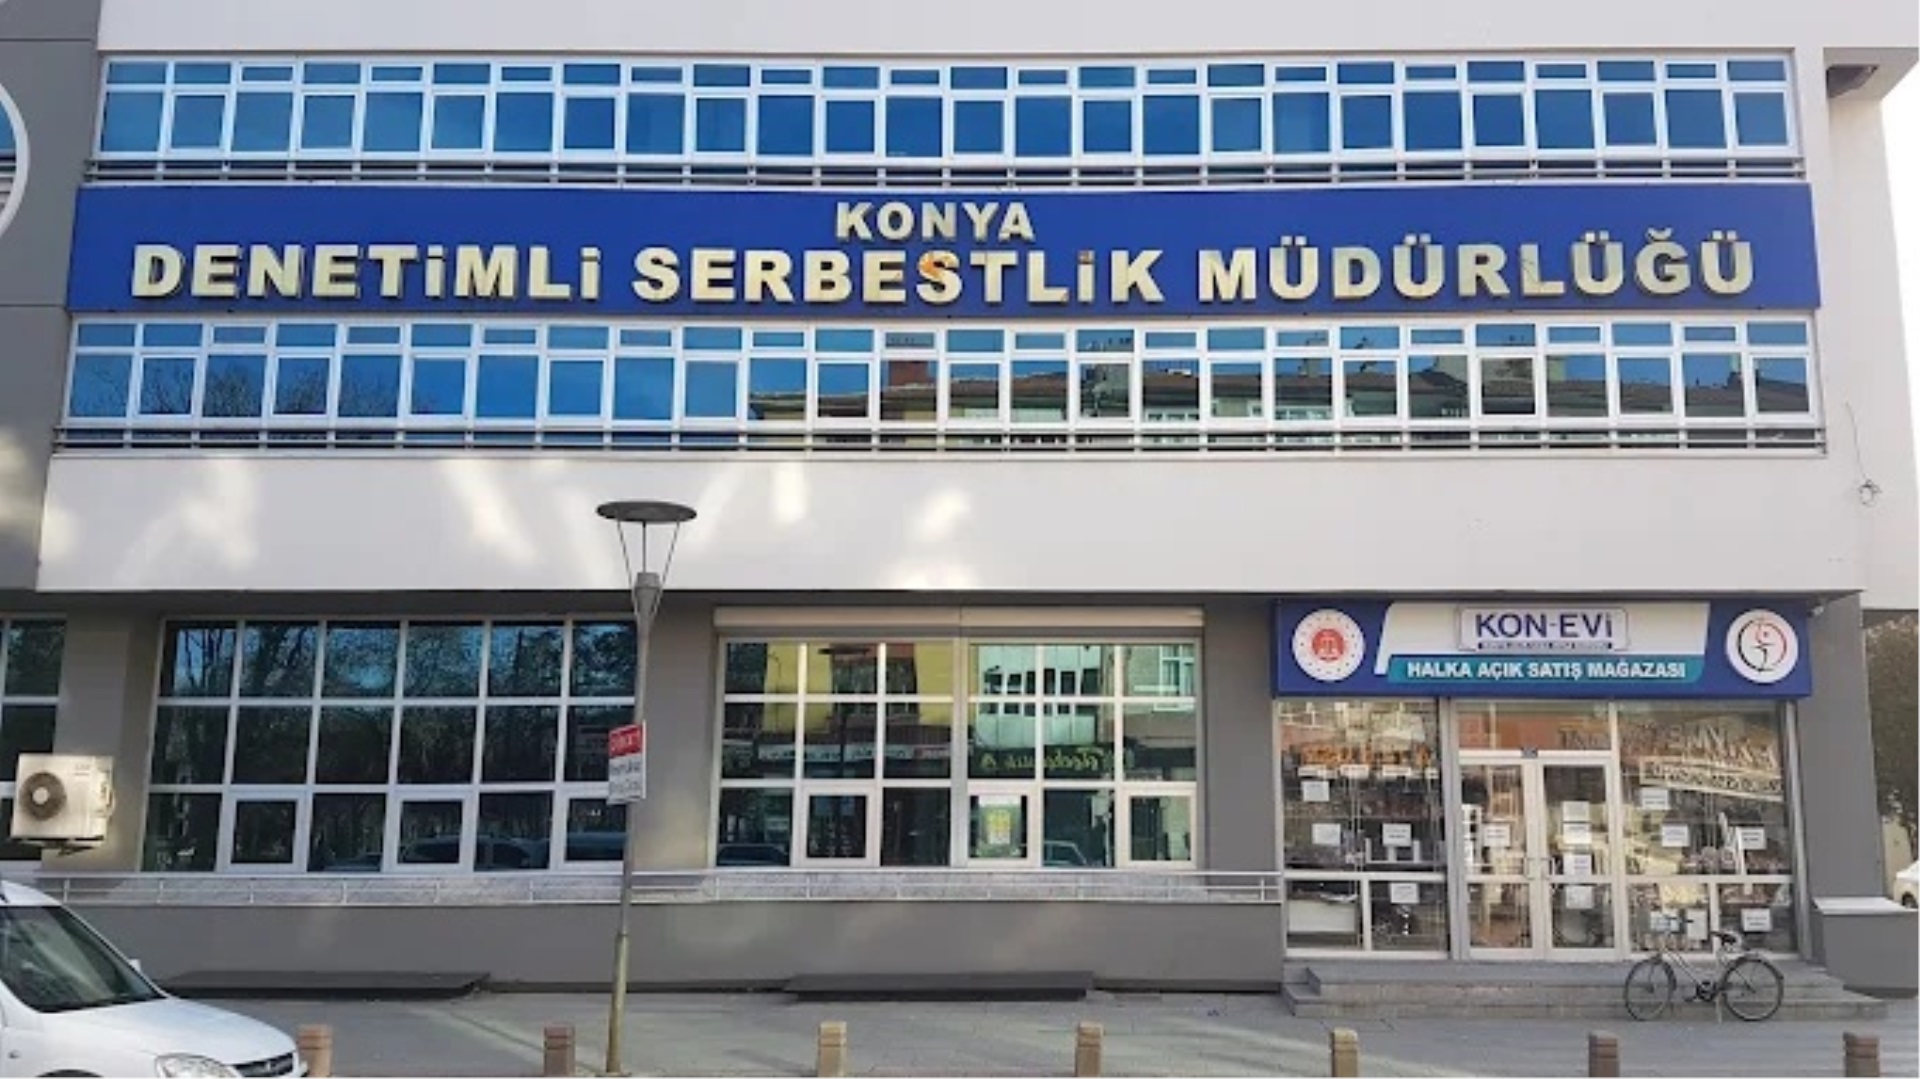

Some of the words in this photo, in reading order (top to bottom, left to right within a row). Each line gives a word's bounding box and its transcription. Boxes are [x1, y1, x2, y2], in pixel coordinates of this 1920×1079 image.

[836, 202, 1034, 240] KONYA
[1198, 228, 1753, 301] MÜDÜRLÜĞÜ
[1407, 662, 1471, 678] HALKA
[1477, 662, 1523, 681] AÇIK
[1528, 662, 1582, 681] SATIŞ
[1587, 658, 1686, 679] MAĞAZASI
